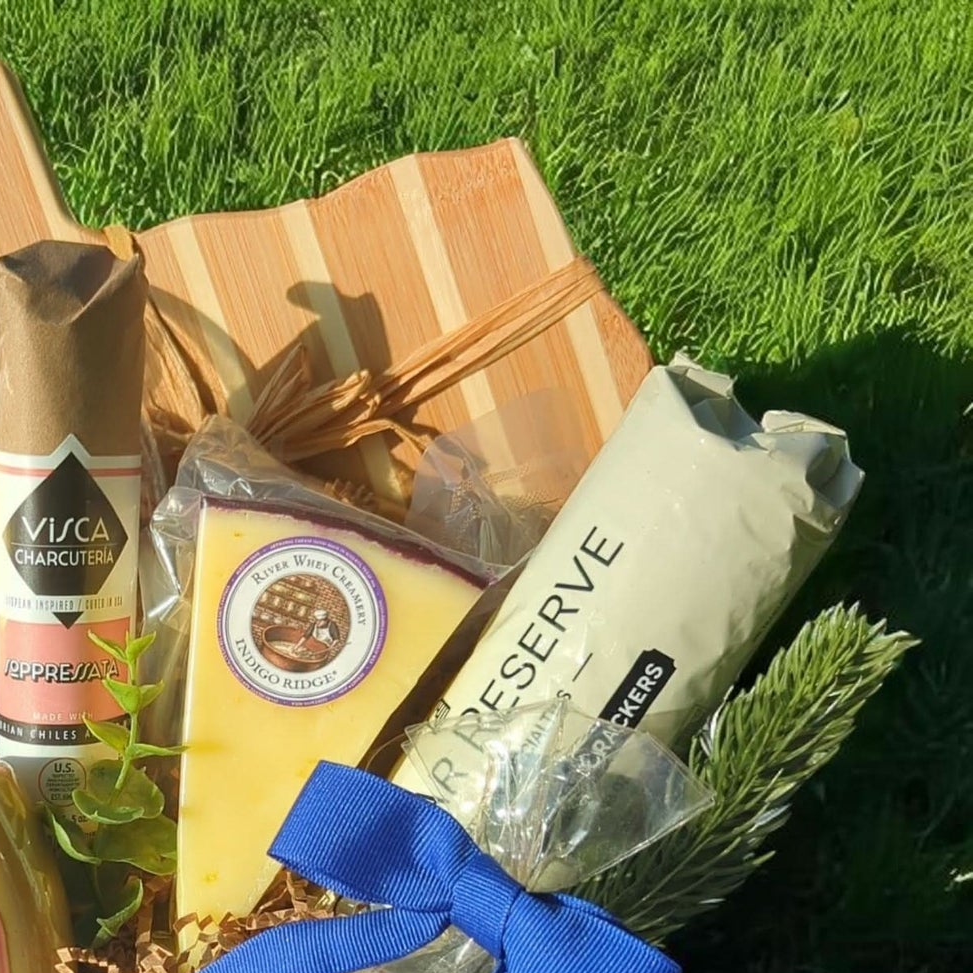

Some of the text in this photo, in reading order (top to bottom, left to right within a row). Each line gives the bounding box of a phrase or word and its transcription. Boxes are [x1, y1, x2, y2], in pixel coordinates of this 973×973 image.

[251, 560, 289, 585] RIVER
[293, 554, 330, 572] WHEY
[331, 565, 366, 626] CREAMERY
[452, 526, 625, 753] RESERVE
[235, 638, 280, 685] INDIGO
[32, 711, 63, 722] MADE
[30, 729, 77, 741] CHILES
[53, 762, 75, 774] U.S.
